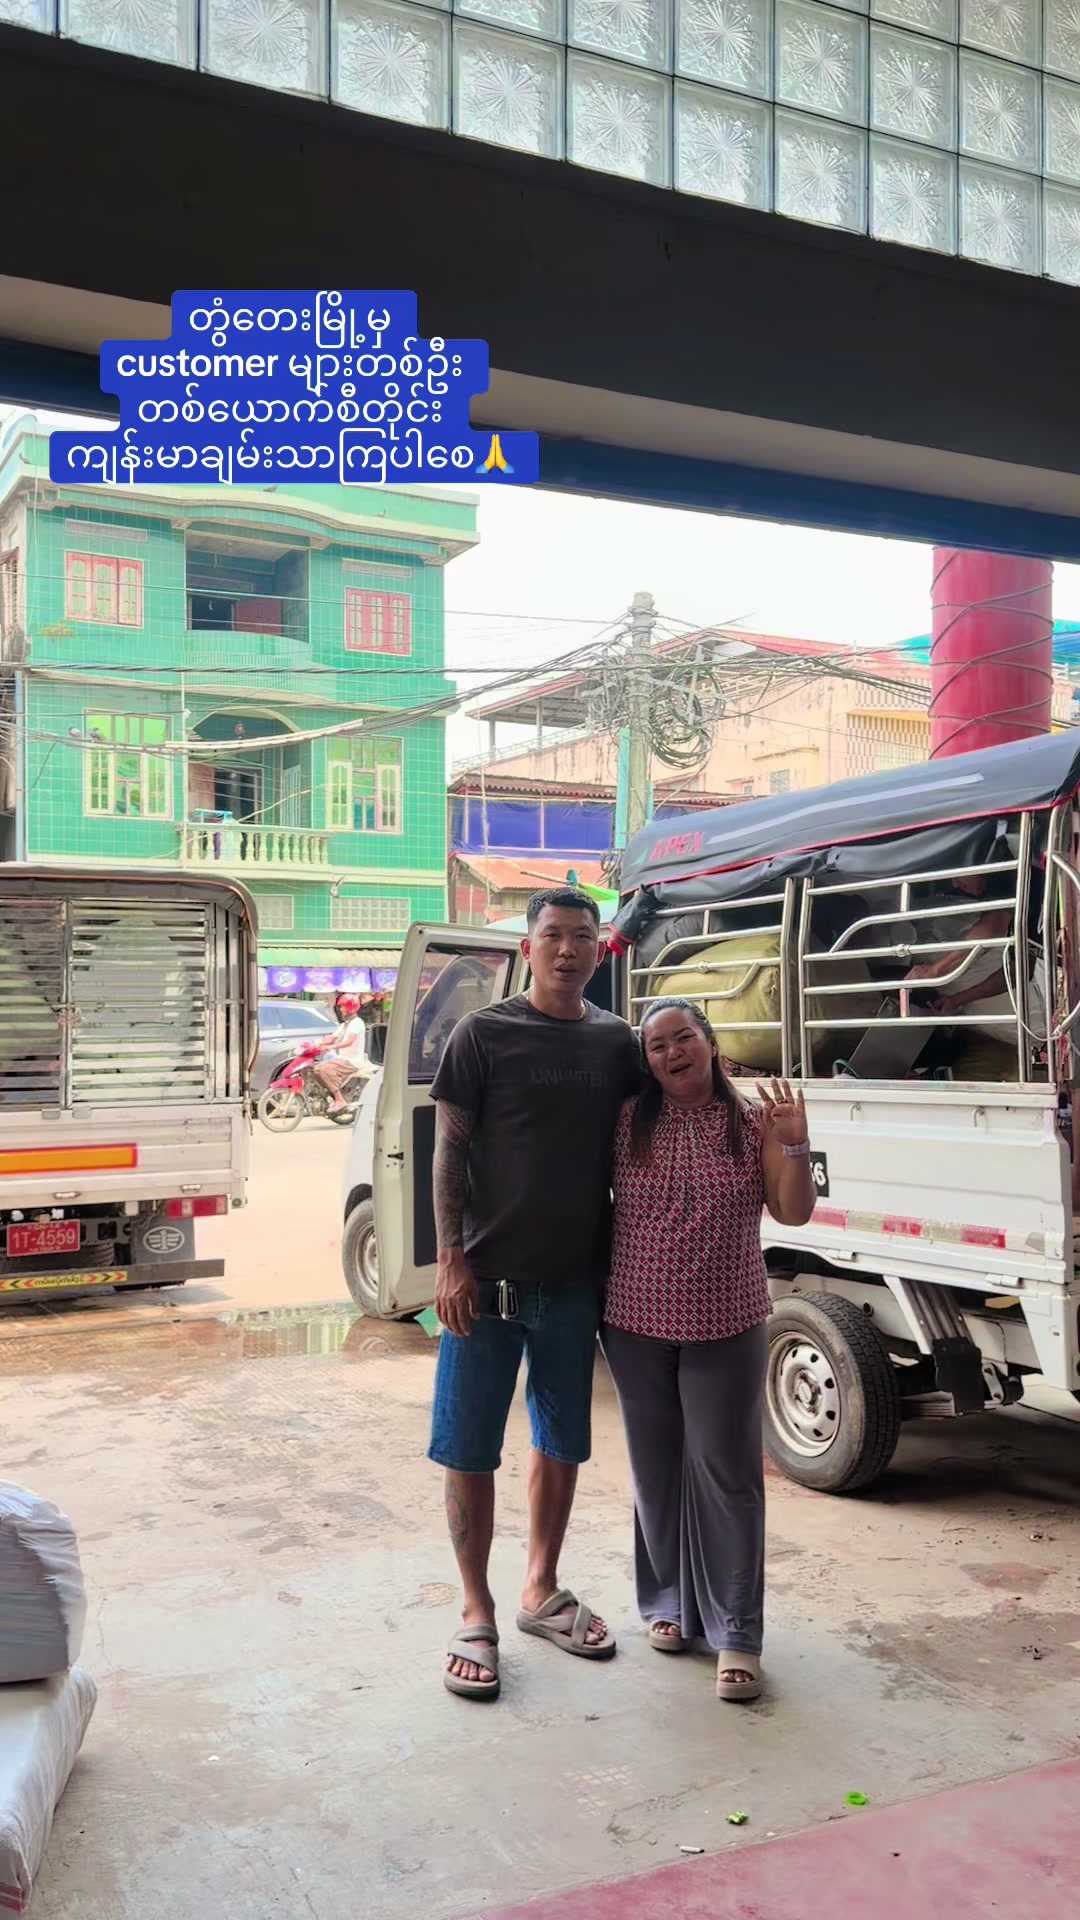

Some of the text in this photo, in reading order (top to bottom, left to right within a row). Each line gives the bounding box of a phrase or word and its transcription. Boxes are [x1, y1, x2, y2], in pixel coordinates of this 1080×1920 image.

[650, 831, 705, 860] APEX
[809, 1161, 827, 1187] 6
[12, 1228, 77, 1249] 1T-4559
